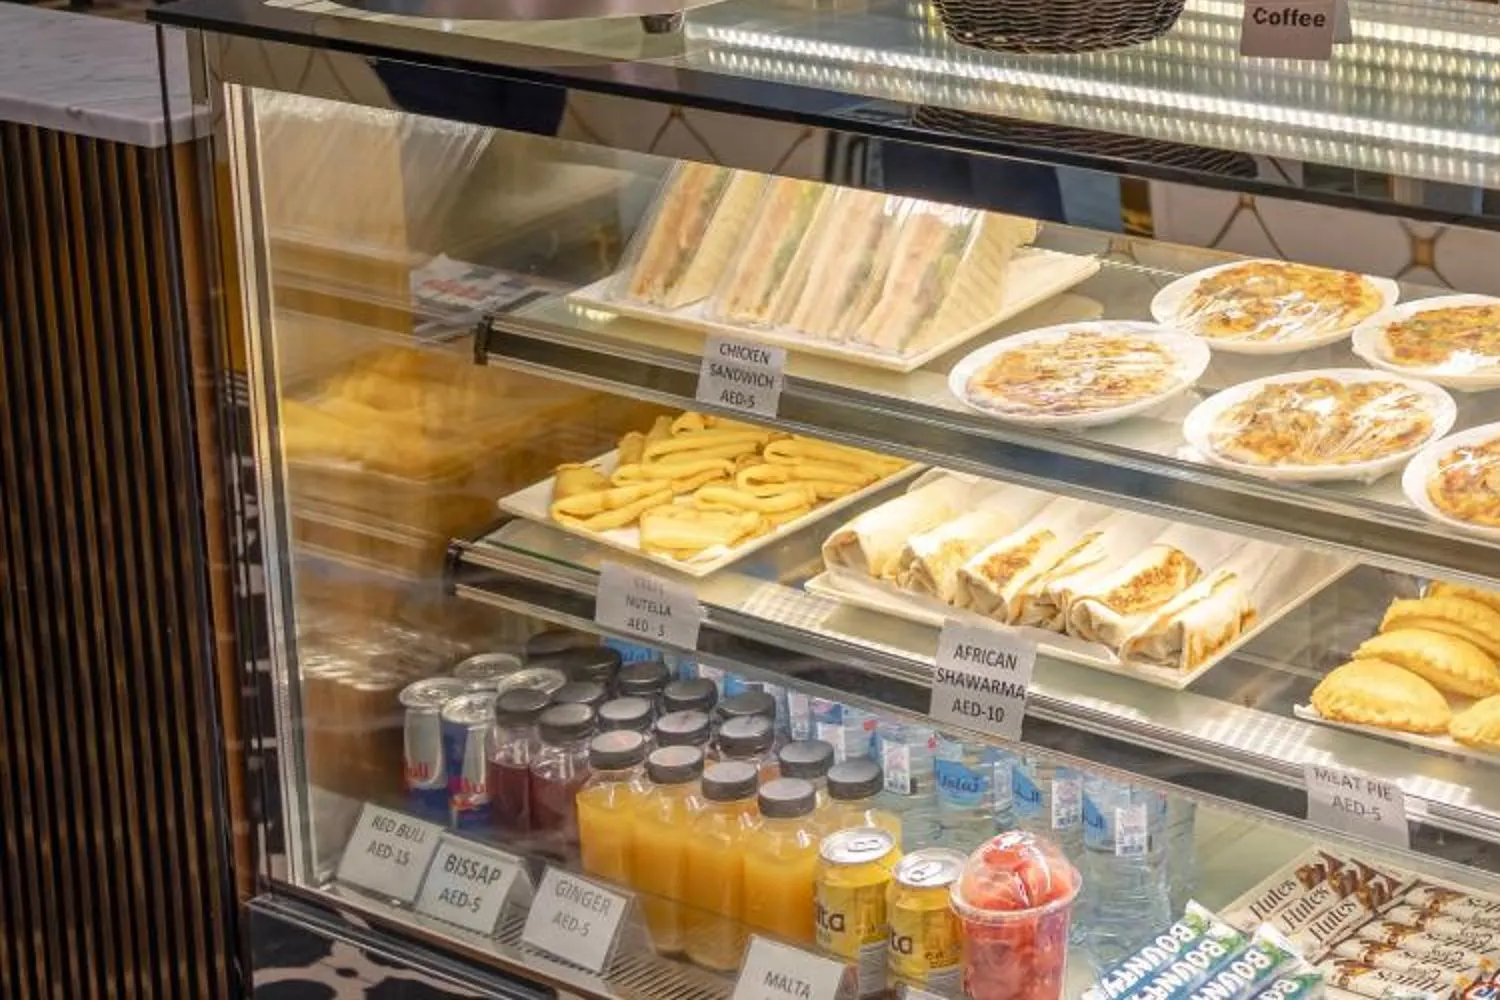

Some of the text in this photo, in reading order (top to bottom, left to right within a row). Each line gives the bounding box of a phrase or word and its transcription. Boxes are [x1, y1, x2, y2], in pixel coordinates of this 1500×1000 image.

[1252, 7, 1326, 27] Coffee
[720, 343, 771, 365] CHICKEN
[710, 363, 774, 389] SANDWICH
[953, 644, 1017, 671] AFRICAN
[937, 667, 1025, 700] SHAWARMA
[952, 698, 1004, 722] AED-10
[1367, 780, 1392, 801] PIE
[1332, 795, 1381, 821] AED-5
[371, 815, 425, 843] RED BULL
[443, 853, 502, 887] BISSAP
[438, 887, 482, 913] AED-5
[555, 880, 611, 917] GINGER
[1281, 885, 1329, 931] Flutes
[552, 910, 591, 937] AED-5
[1308, 899, 1357, 941] Flutes
[1101, 923, 1196, 998] BOUNTY
[1189, 948, 1273, 1000] BOUN
[763, 971, 811, 999] MALTA
